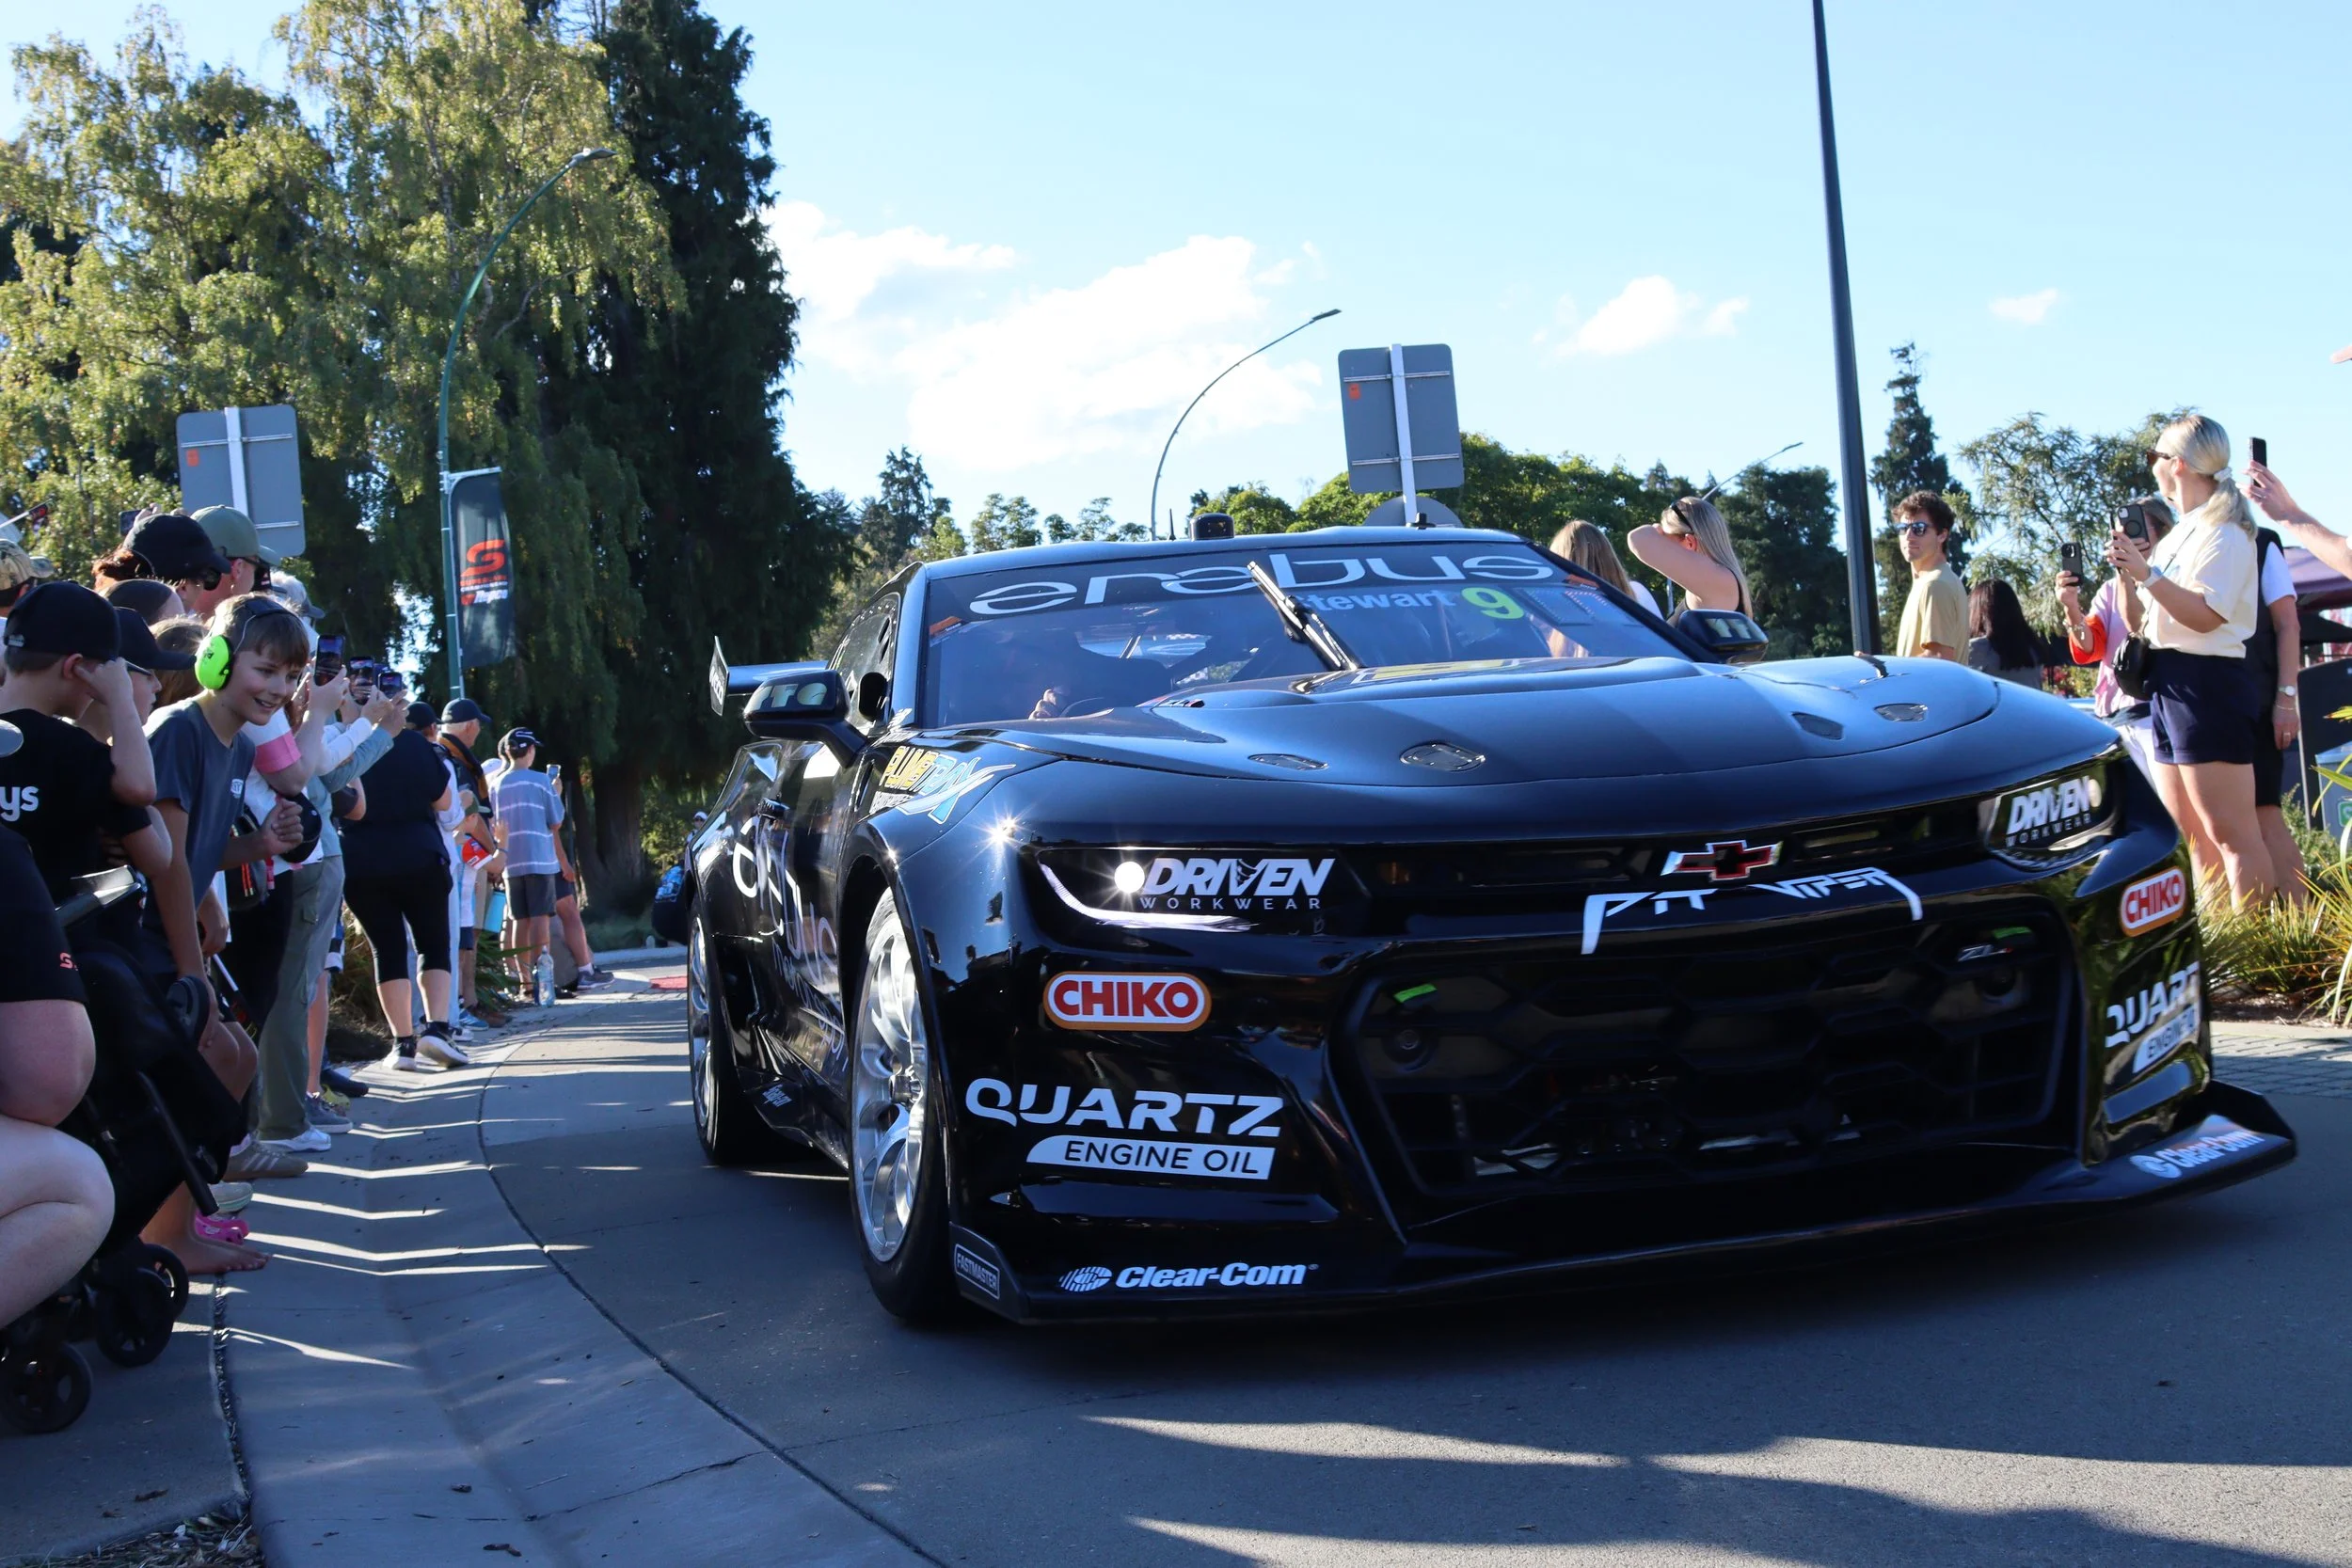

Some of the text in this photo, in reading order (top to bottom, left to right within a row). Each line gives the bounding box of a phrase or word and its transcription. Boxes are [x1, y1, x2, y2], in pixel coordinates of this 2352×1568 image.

[969, 553, 1553, 614] erebus
[1462, 588, 1524, 619] 9
[2006, 775, 2090, 835] DRIVEN
[2005, 813, 2091, 847] WORKWEAR
[1144, 857, 1335, 895] DRIVEN
[1747, 867, 1923, 922] VIPER
[1140, 897, 1321, 910] WORKWEAR
[2125, 874, 2181, 924] CHIKO
[1053, 980, 1199, 1019] CHIKO
[965, 1077, 1284, 1137] QUARTZ
[1064, 1140, 1259, 1175] ENGINE OIL
[957, 1252, 997, 1291] FASTMASTER
